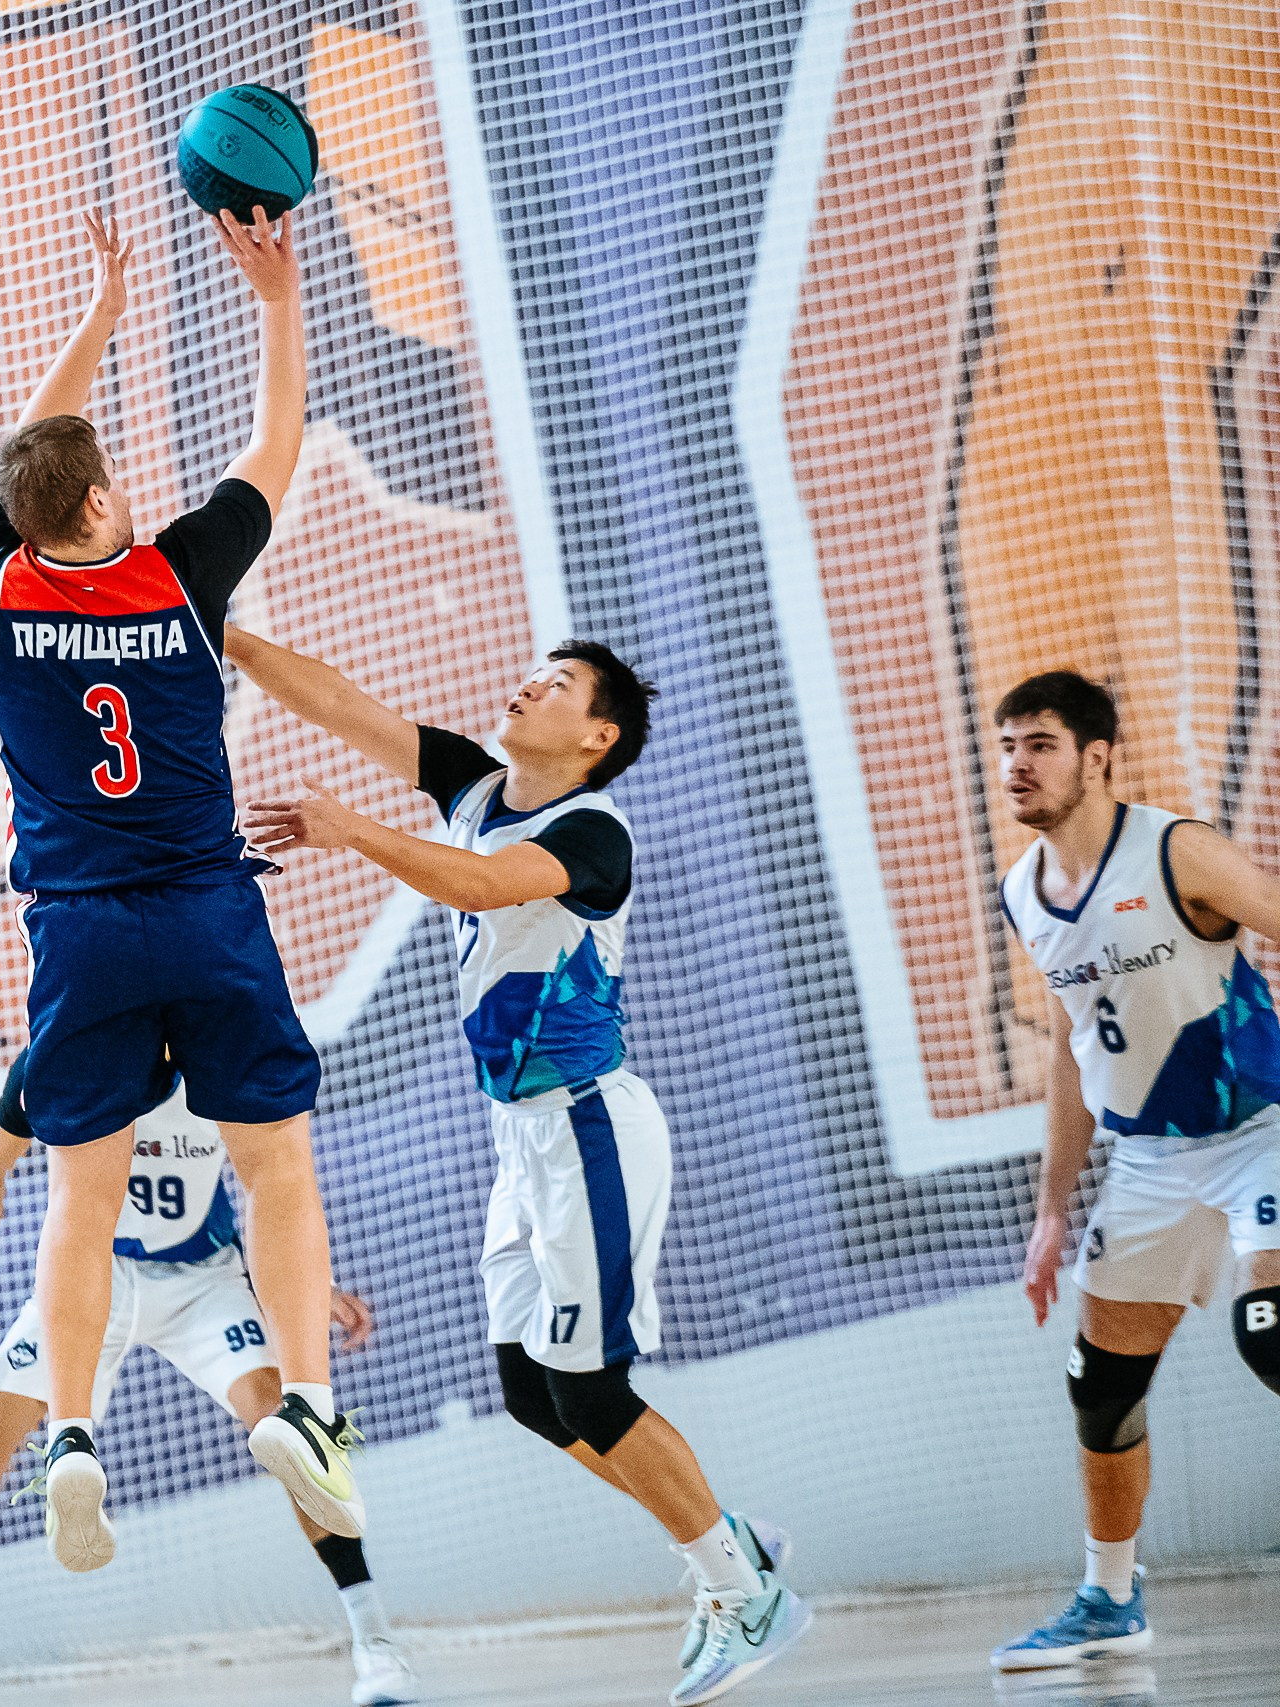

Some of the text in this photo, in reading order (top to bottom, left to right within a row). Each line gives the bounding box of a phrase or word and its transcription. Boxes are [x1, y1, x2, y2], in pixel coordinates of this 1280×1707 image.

[11, 618, 188, 667] ПРИЩЕПА
[82, 682, 142, 799] 3
[1096, 994, 1128, 1055] 6
[127, 1174, 186, 1220] 99
[1255, 1193, 1278, 1226] 6
[223, 1318, 267, 1353] 99
[549, 1303, 581, 1345] 17
[1245, 1300, 1277, 1333] B
